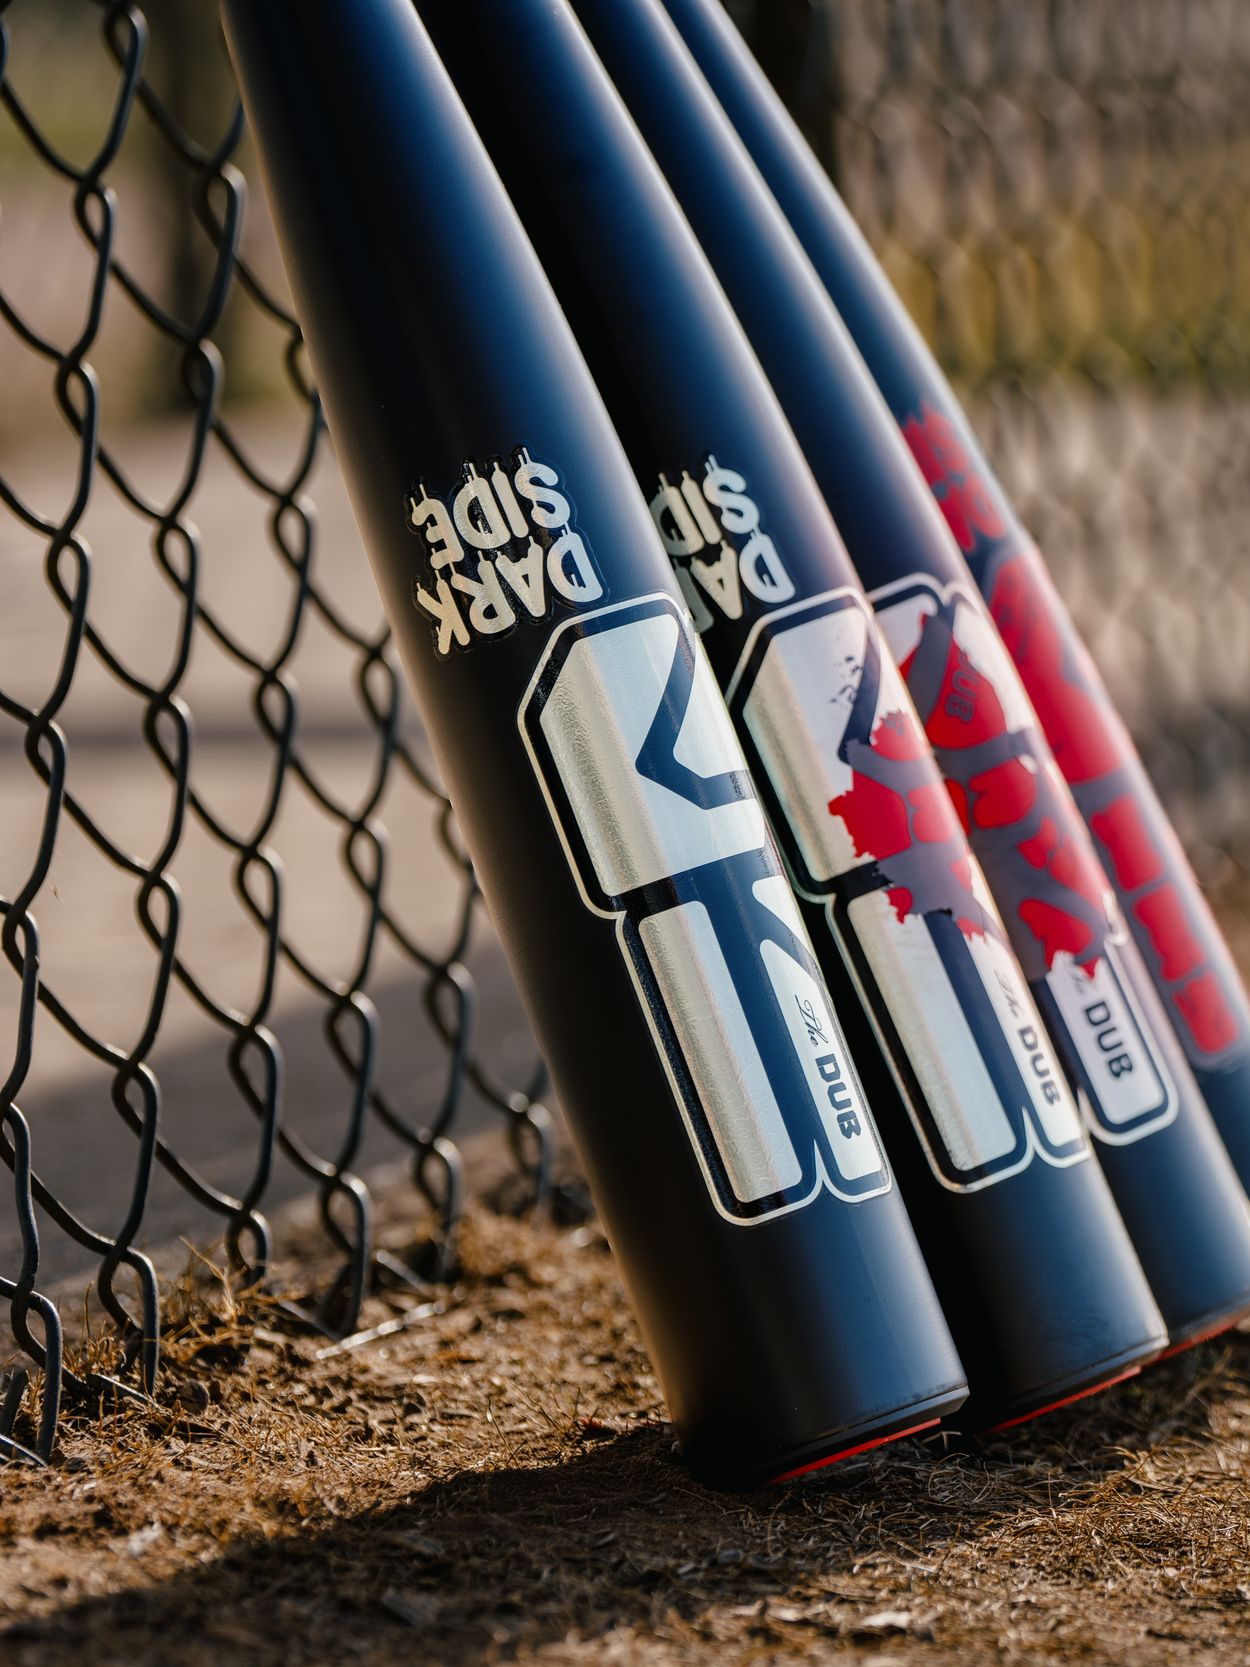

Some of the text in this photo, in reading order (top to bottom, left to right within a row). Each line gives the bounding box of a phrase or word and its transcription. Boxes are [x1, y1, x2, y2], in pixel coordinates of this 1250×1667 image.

[411, 447, 571, 570] SIDE
[650, 454, 760, 557] SID
[417, 525, 603, 655] DARK
[674, 532, 796, 633] DA
[795, 994, 861, 1139] The DUB
[1018, 1025, 1060, 1105] DUB
[1085, 1001, 1133, 1078] DUB
